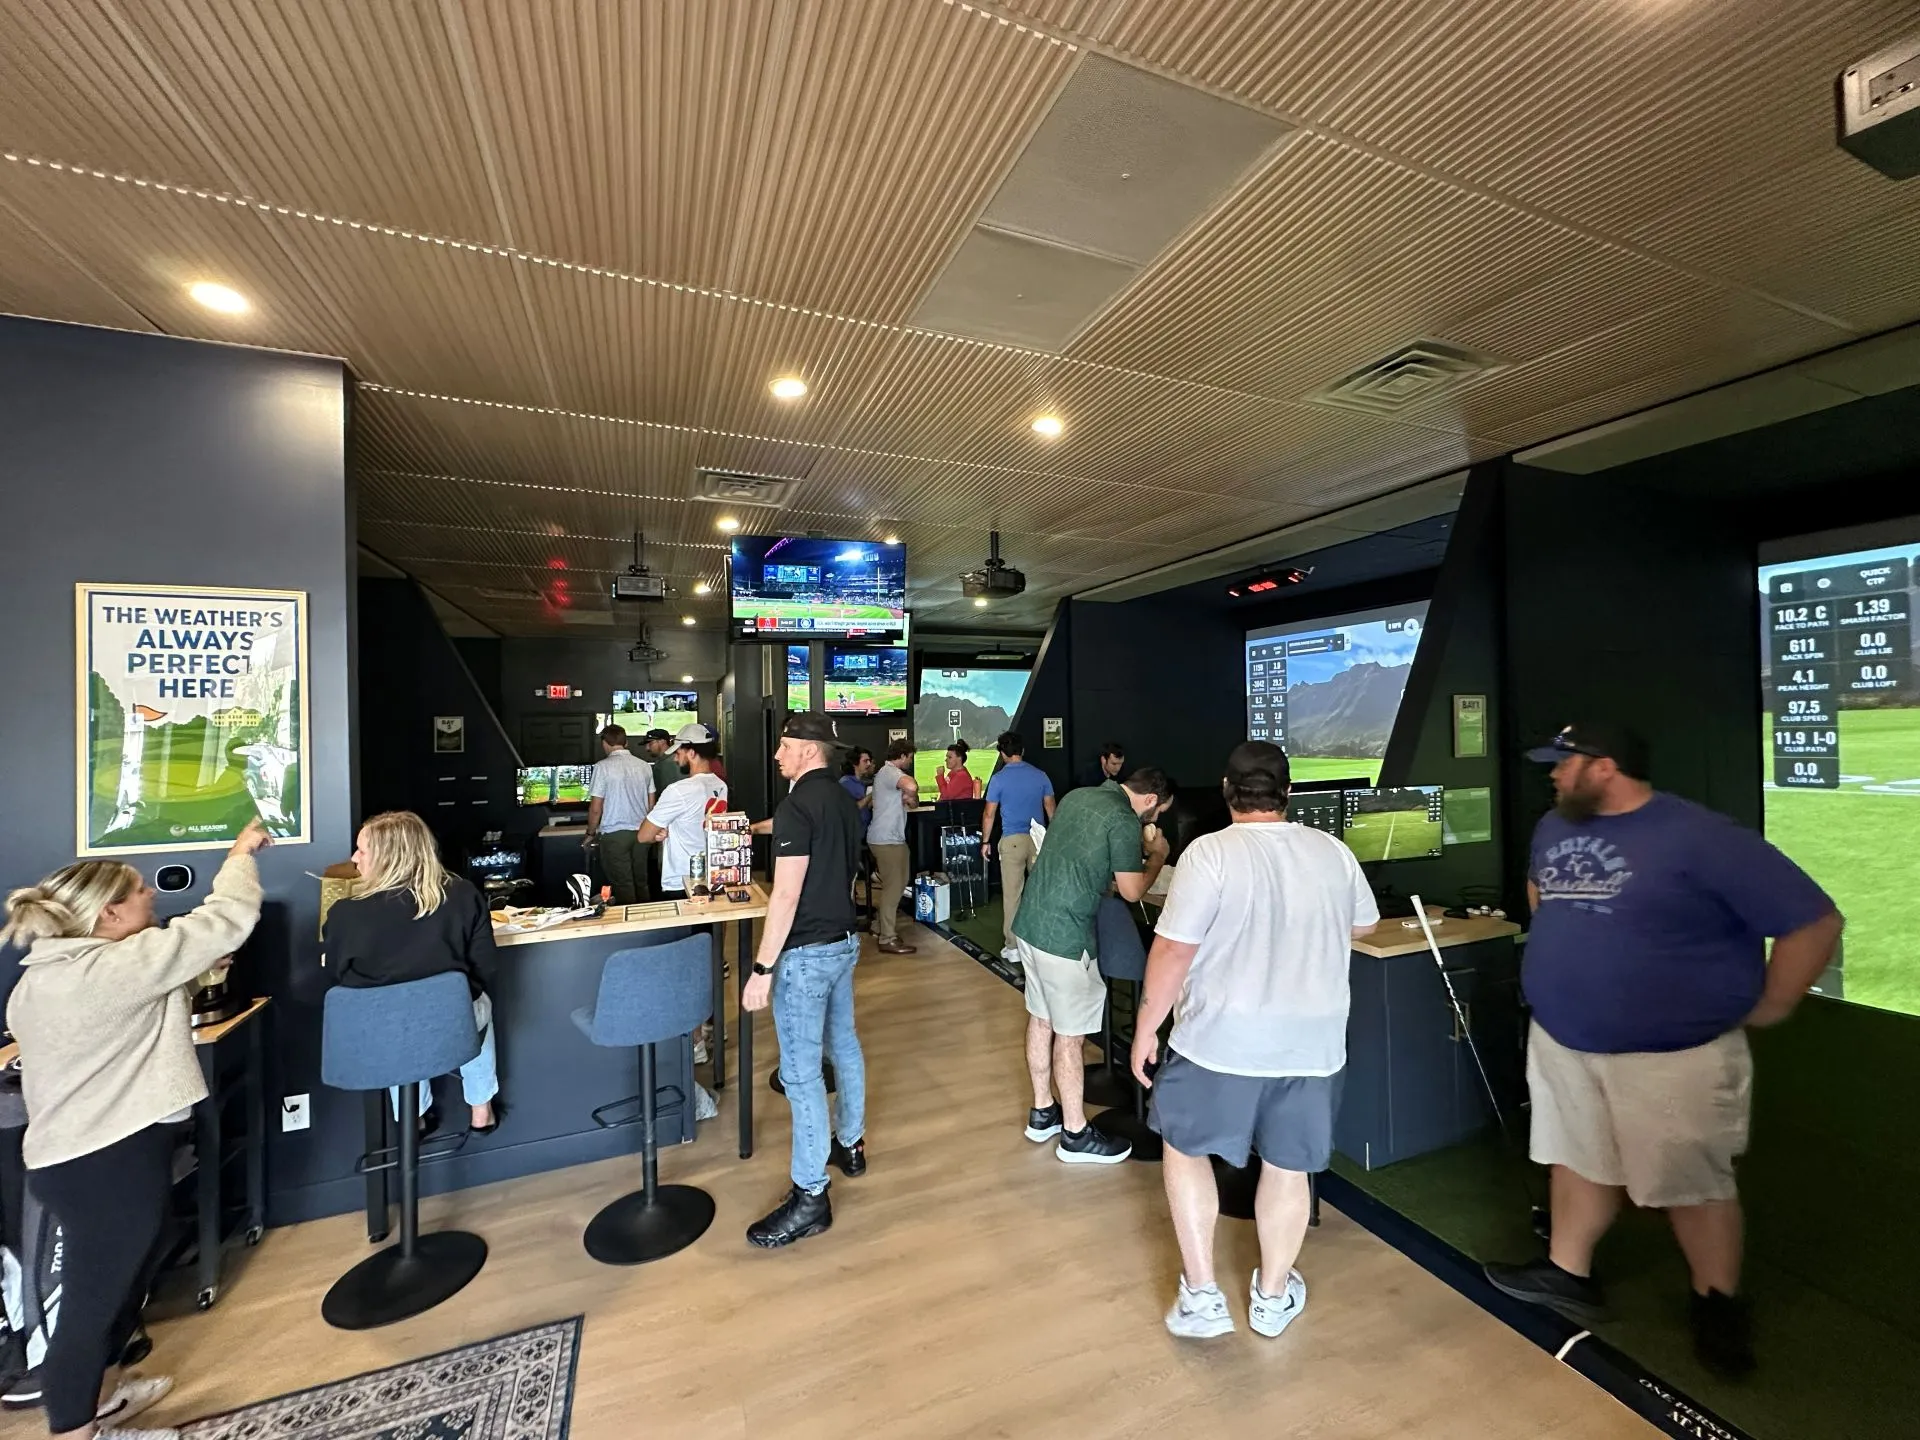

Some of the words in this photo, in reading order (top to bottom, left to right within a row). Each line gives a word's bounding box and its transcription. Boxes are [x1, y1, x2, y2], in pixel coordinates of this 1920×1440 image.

[1860, 567, 1891, 578] QUICK
[1866, 577, 1886, 586] CTP
[1777, 607, 1808, 623] 10.2
[1815, 605, 1827, 619] C
[1854, 598, 1890, 615] 1.39
[102, 606, 147, 624] THE
[154, 608, 283, 628] WEATHER'S
[1807, 620, 1830, 628] PATH
[1840, 616, 1870, 624] SMASH
[1870, 613, 1906, 622] FACTOR
[135, 628, 254, 650] ALWAYS
[1789, 638, 1815, 653] 611
[1860, 631, 1886, 648] 0.0
[127, 653, 252, 675] PERFECT
[1792, 669, 1814, 684] 4.1
[1861, 665, 1887, 680] 0.0
[159, 678, 234, 698] HERE
[550, 685, 568, 698] EXIT
[1798, 683, 1830, 691] HEIGHT
[1875, 680, 1897, 688] LOFT
[1788, 700, 1820, 714] 97.5
[1775, 731, 1806, 745] 11.9
[1794, 762, 1817, 776] 0.0
[1639, 1379, 1676, 1402] ONE
[1675, 1401, 1739, 1440] PERSO
[1665, 1411, 1692, 1428] AT
